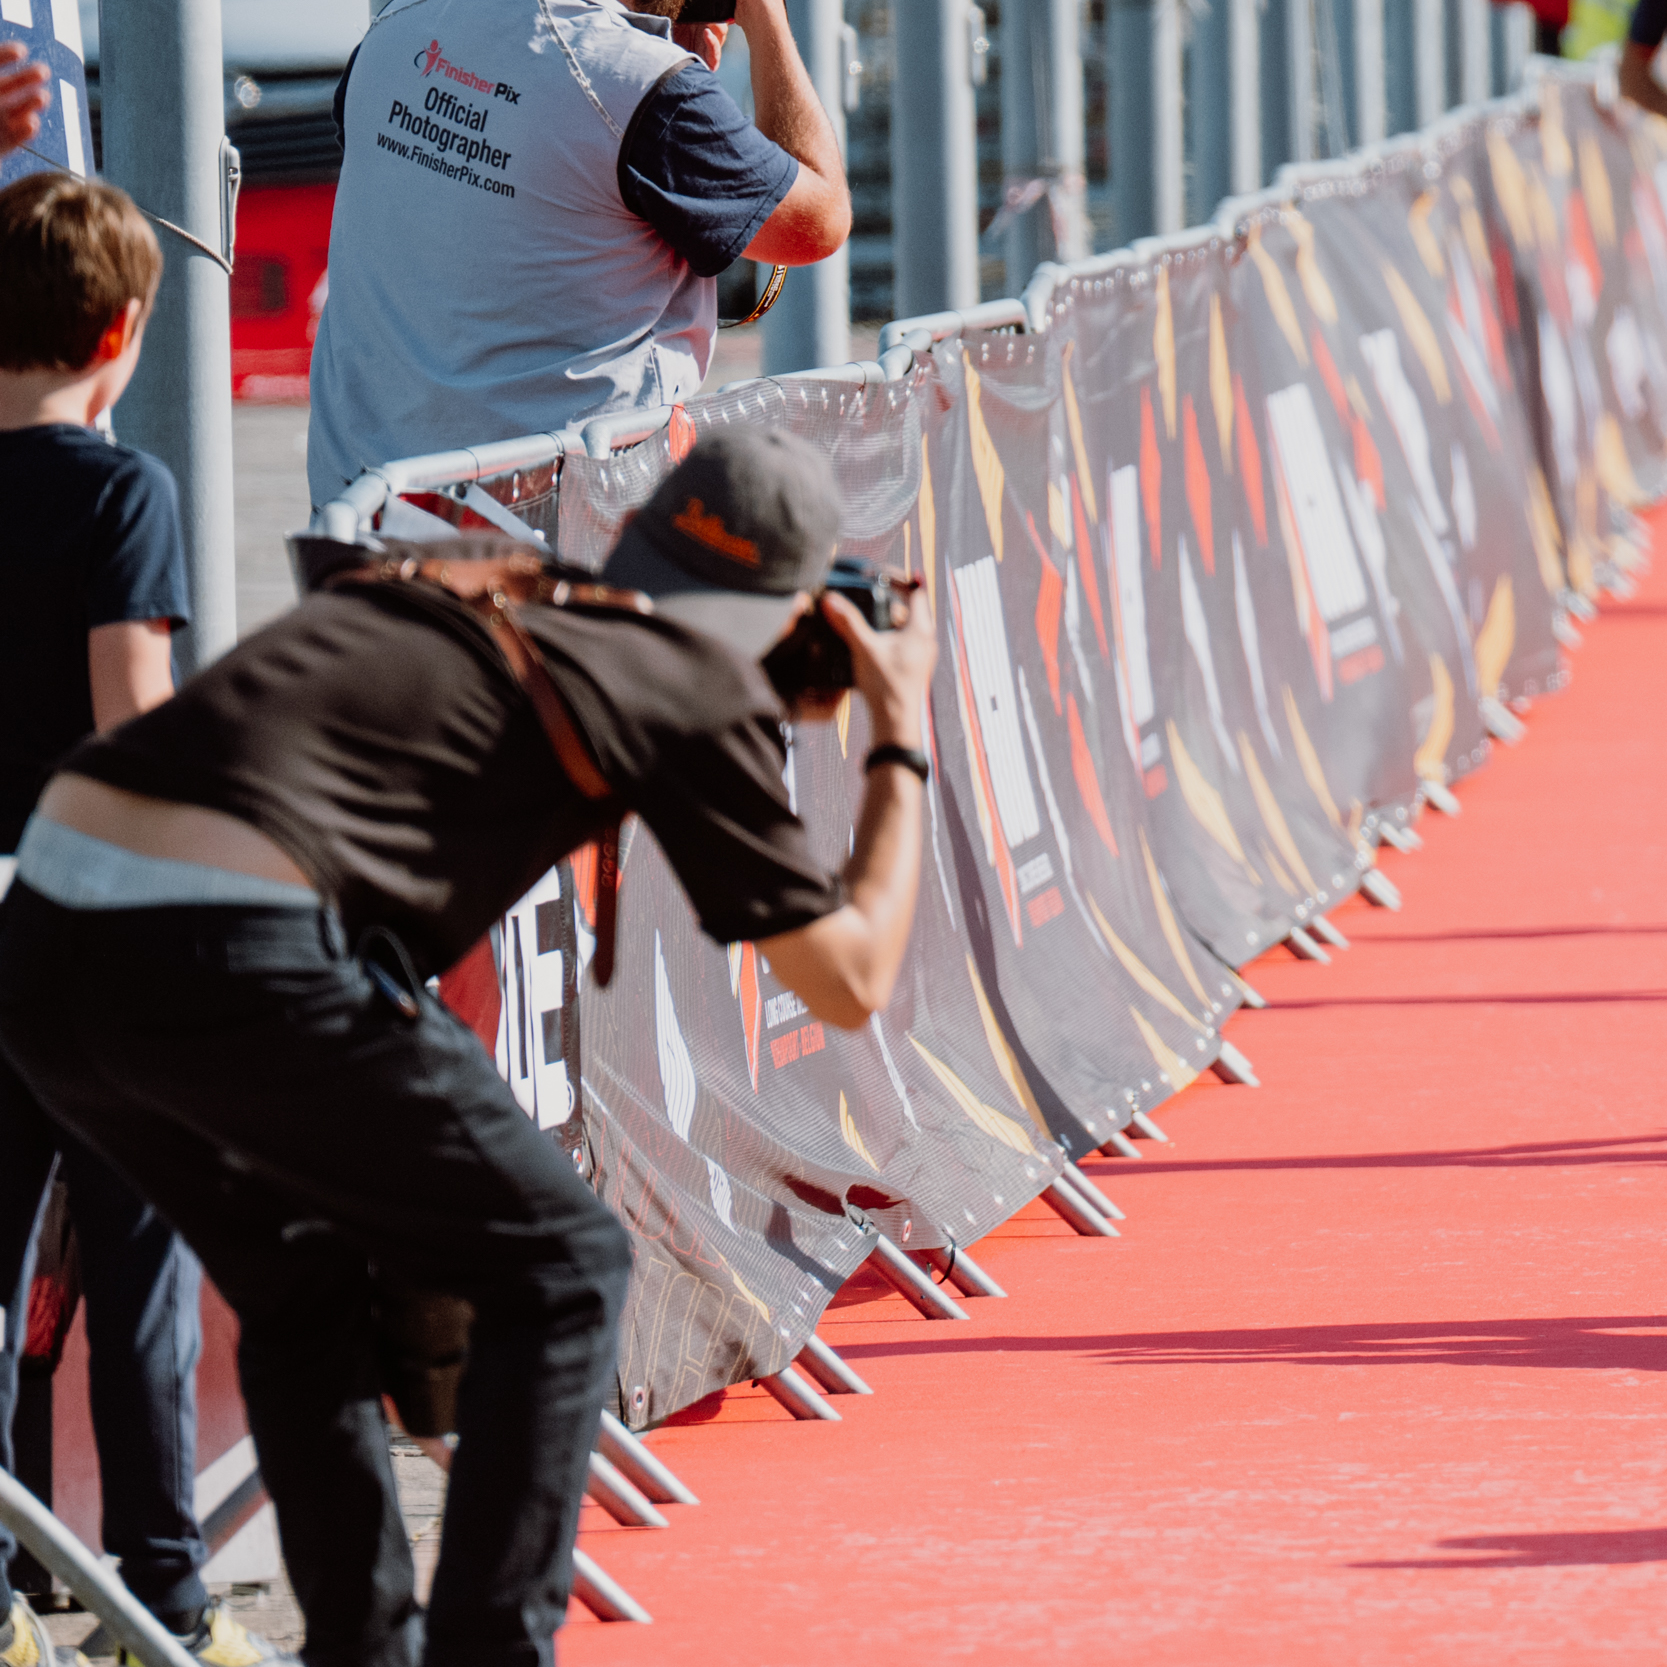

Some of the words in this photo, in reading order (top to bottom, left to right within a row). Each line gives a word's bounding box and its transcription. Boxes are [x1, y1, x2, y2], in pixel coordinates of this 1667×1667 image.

[388, 100, 512, 171] Photographer
[424, 86, 489, 133] Official
[376, 132, 515, 198] www.FinisherPix.com
